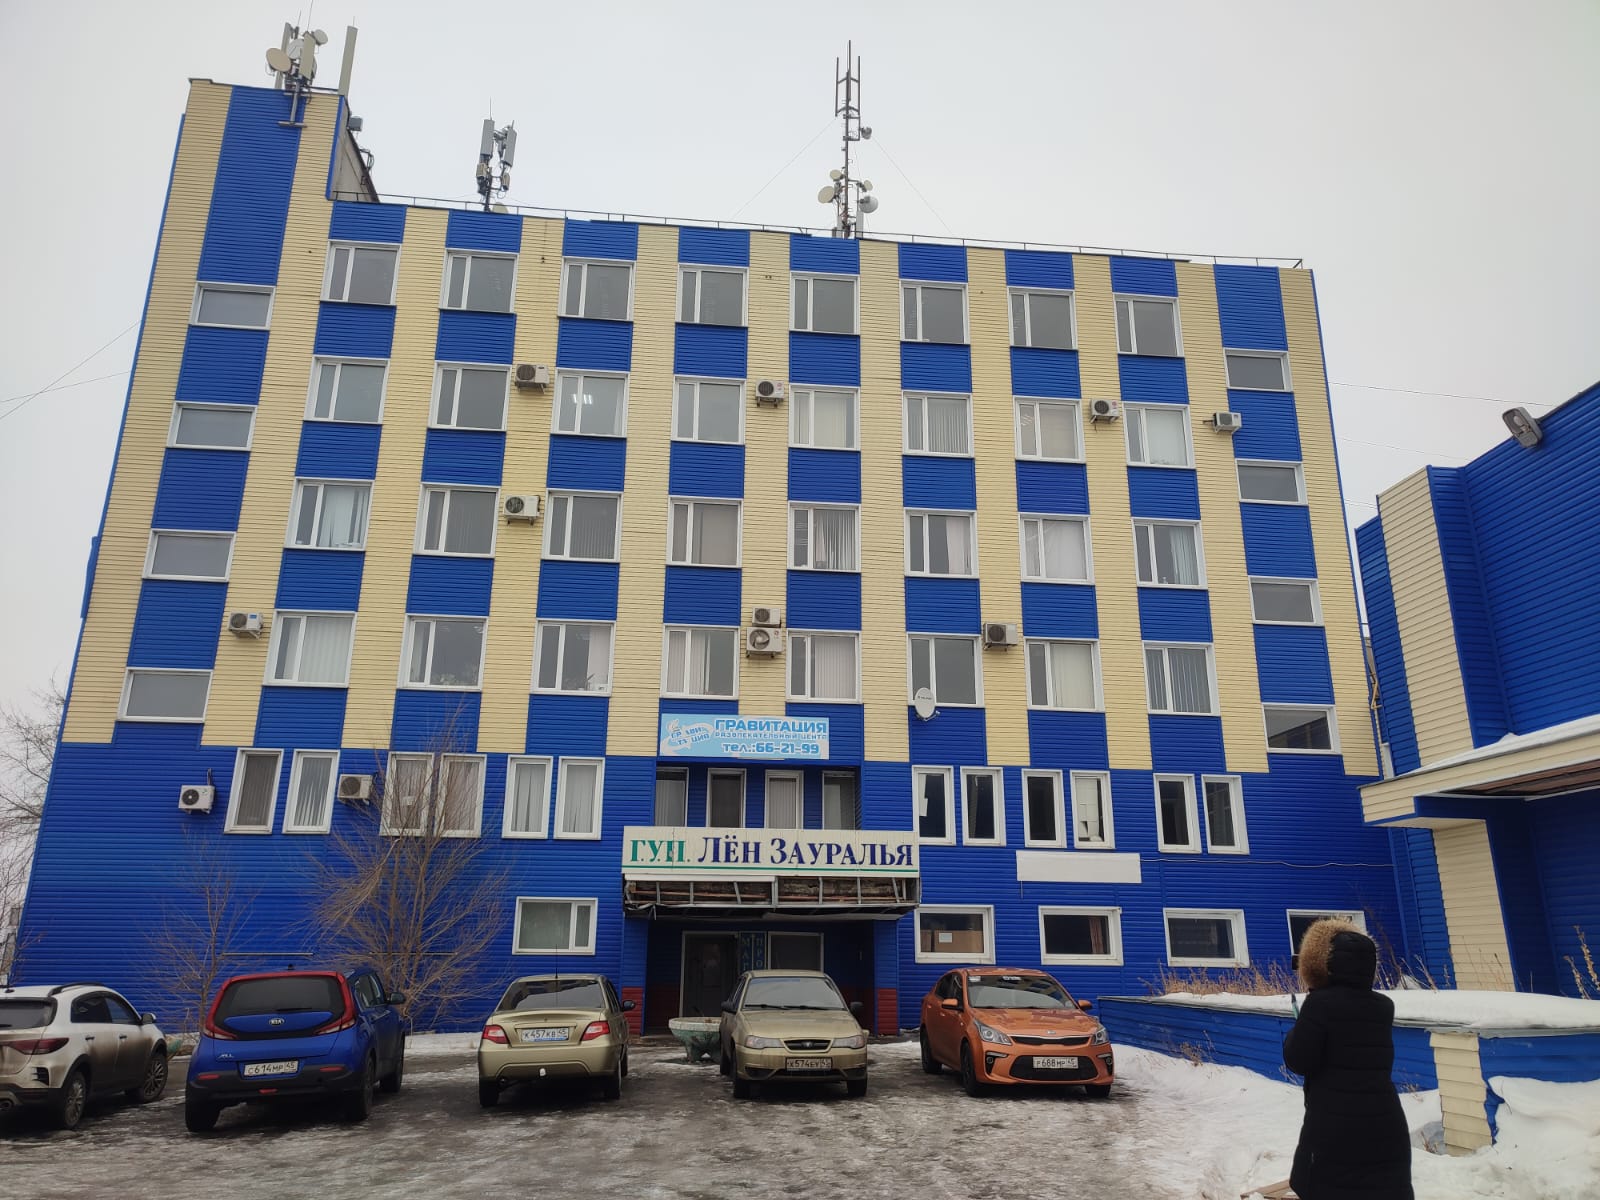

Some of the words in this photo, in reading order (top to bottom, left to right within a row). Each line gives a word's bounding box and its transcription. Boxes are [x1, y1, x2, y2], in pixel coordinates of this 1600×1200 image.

[715, 719, 827, 734] ГРАВИТАЦИЯ
[630, 839, 691, 863] Г.У.П.
[698, 835, 762, 864] ЛЁН
[770, 837, 914, 866] ЗАУРАЛЬЯ
